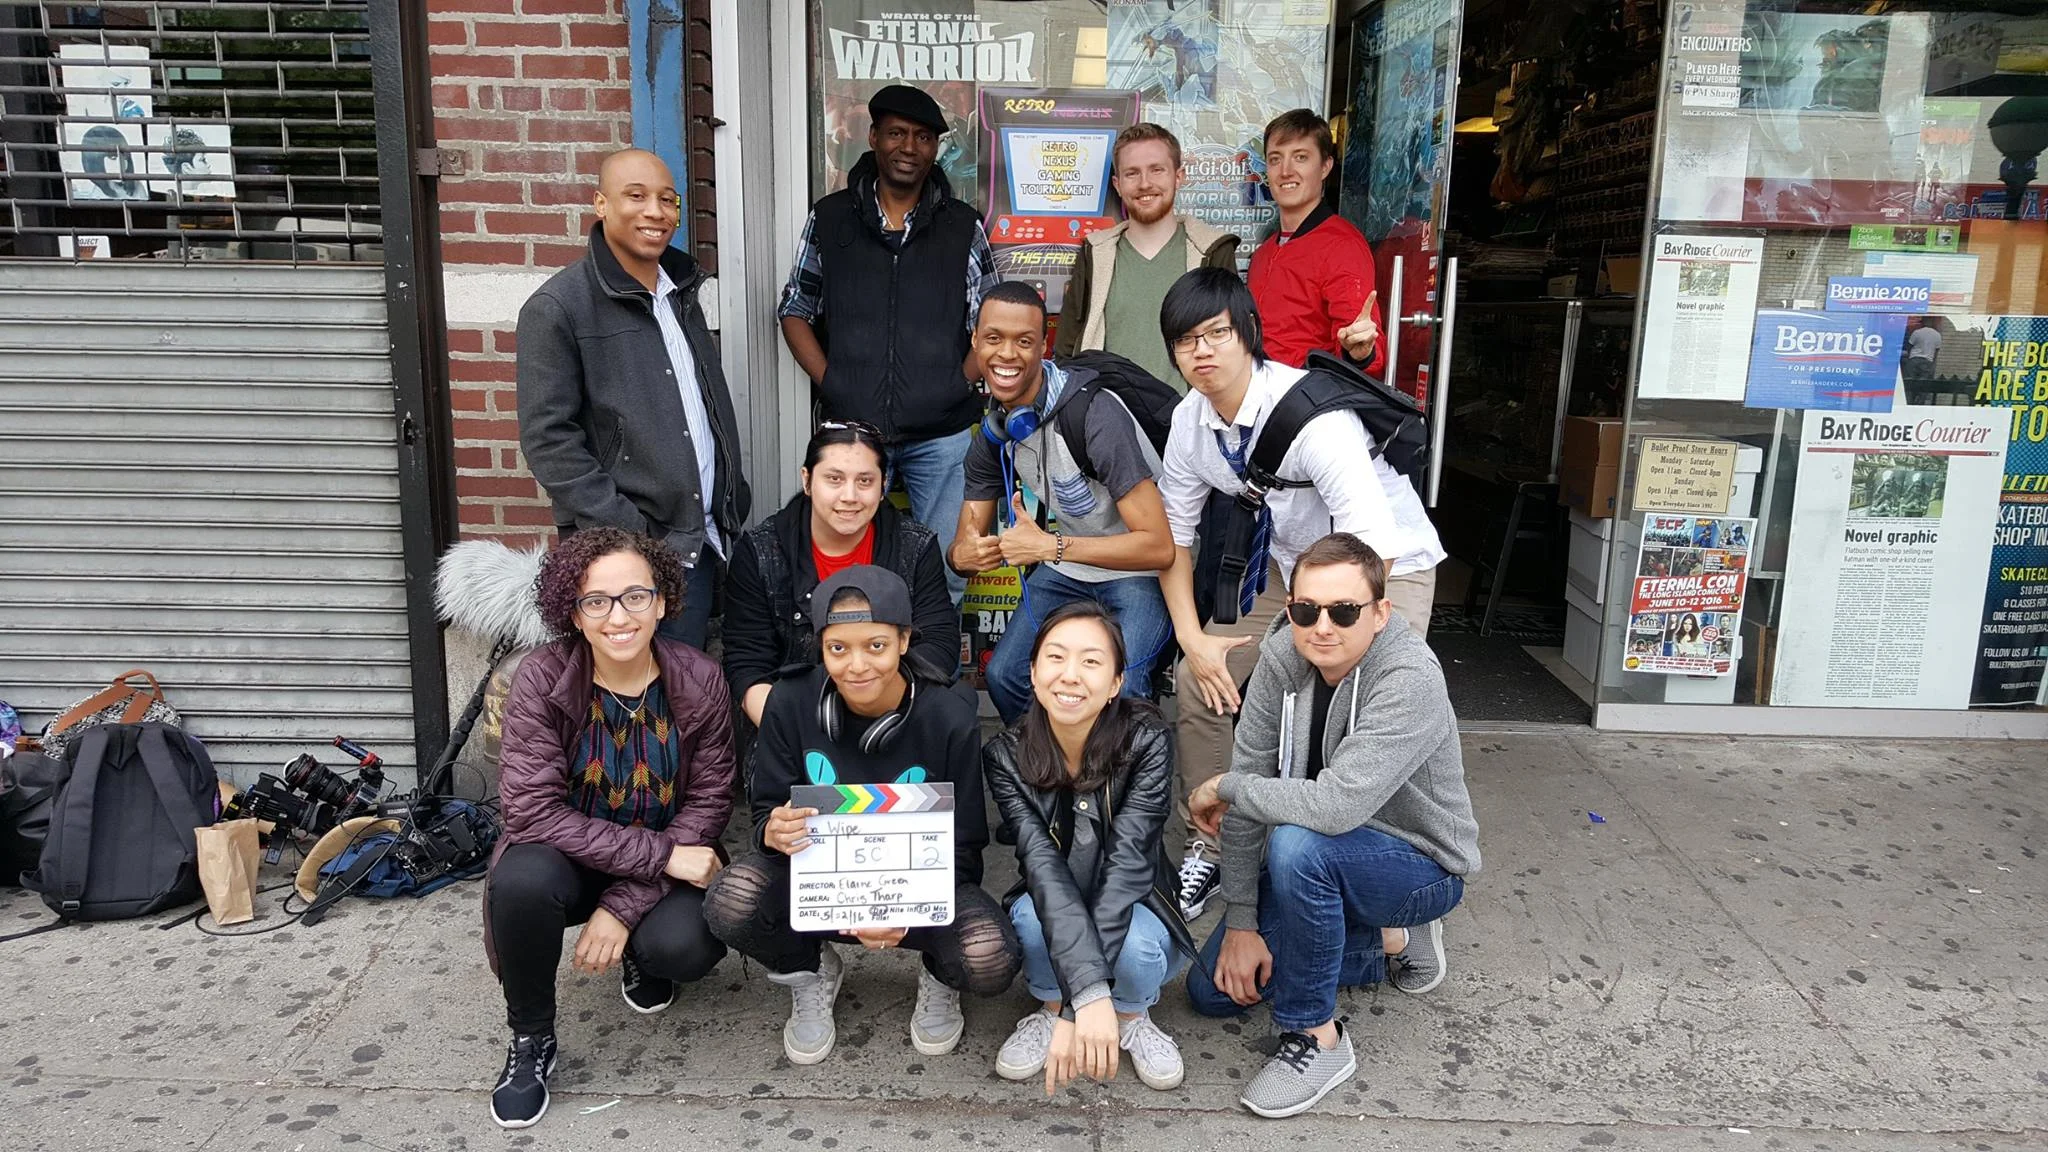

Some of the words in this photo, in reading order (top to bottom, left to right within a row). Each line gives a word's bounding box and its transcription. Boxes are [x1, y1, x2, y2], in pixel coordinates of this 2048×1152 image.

[881, 12, 929, 20] WRATH
[933, 13, 952, 21] OF
[856, 20, 1004, 44] ETERNAL
[1681, 36, 1752, 52] ENCOUNTERS
[829, 27, 1035, 82] WARRIOR
[1686, 62, 1717, 75] PLAYED
[1719, 63, 1742, 75] HERE
[1685, 75, 1704, 83] EVERY
[1706, 75, 1741, 84] WEDNESDAY
[1692, 88, 1708, 96] PM
[1710, 88, 1740, 100] Sharp!
[1004, 99, 1056, 114] RETRO
[1053, 107, 1113, 118] NEXUS
[1042, 141, 1077, 152] RETRO
[1042, 156, 1076, 166] NEXUS
[1183, 160, 1246, 176] u-Gi-Oh!
[1038, 170, 1080, 181] GAMING
[1021, 184, 1093, 196] TOURNAMENT
[1179, 193, 1240, 205] WORLD
[1664, 242, 1682, 255] BAY
[1683, 243, 1712, 257] RIDGE
[1712, 244, 1753, 258] Courier
[1011, 251, 1041, 264] THIS
[1043, 252, 1077, 265] FRID
[1829, 283, 1890, 300] Bernie
[1892, 286, 1929, 301] 2016
[1676, 302, 1696, 310] Novel
[1698, 302, 1725, 311] graphic
[1774, 325, 1884, 357] Bernie
[1982, 341, 2018, 368] THE
[1808, 366, 1860, 375] PRESIDENT
[1790, 379, 1854, 388] BERNIESANDERS.COM
[1975, 369, 2029, 401] ARE
[1820, 416, 1857, 440] BAY
[1859, 417, 1913, 442] RIDGE
[1915, 418, 1991, 444] Courier
[1651, 443, 1669, 452] Bullet
[1672, 443, 1690, 453] Proof
[1691, 444, 1707, 454] Store
[1709, 445, 1728, 456] Hours
[1660, 456, 1682, 465] Monday
[1690, 457, 1715, 467] Saturday
[1651, 466, 1664, 475] Open
[1667, 466, 1682, 475] 11am
[1689, 467, 1708, 476] Closed
[1674, 477, 1695, 486] Sunday
[1647, 485, 1661, 495] Open
[1664, 486, 1679, 495] 11am
[1686, 487, 1704, 496] Closed
[1706, 489, 1718, 497] 6pm
[1997, 505, 2048, 525] KATEBO
[1844, 529, 1882, 543] Novel
[1887, 529, 1938, 546] graphic
[1993, 526, 2031, 546] SHOP
[2033, 527, 2048, 546] IN
[967, 575, 1017, 586] ftware
[1640, 576, 1703, 592] ETERNAL
[1706, 574, 1739, 589] CON
[1639, 592, 1651, 600] THE
[1652, 590, 1672, 599] LONG
[1672, 589, 1696, 598] ISLAND
[1697, 588, 1720, 596] COMIC
[1720, 586, 1736, 594] CON
[2020, 585, 2032, 596] $10
[963, 593, 1021, 606] uarante
[1649, 598, 1674, 608] JUNE
[1676, 597, 1699, 606] 10-12
[1700, 596, 1723, 605] 2016
[2003, 598, 2010, 608] 6
[2010, 598, 2036, 608] CLASSES
[1992, 611, 2007, 621] ONE
[2008, 611, 2023, 621] FREE
[2023, 611, 2040, 620] CLASS
[1983, 624, 2026, 634] SKATEBOARD
[1983, 647, 2011, 657] FOLLOW
[2011, 648, 2021, 657] US
[827, 820, 862, 839] Wipe
[922, 847, 942, 867] 2
[799, 881, 836, 890] DIRECTOR:
[839, 877, 873, 890] Elaine
[879, 875, 909, 886] Green
[799, 895, 830, 903] CAMERA:
[837, 891, 868, 905] Chris
[870, 889, 903, 906] Tharp
[799, 910, 820, 918] DATE:
